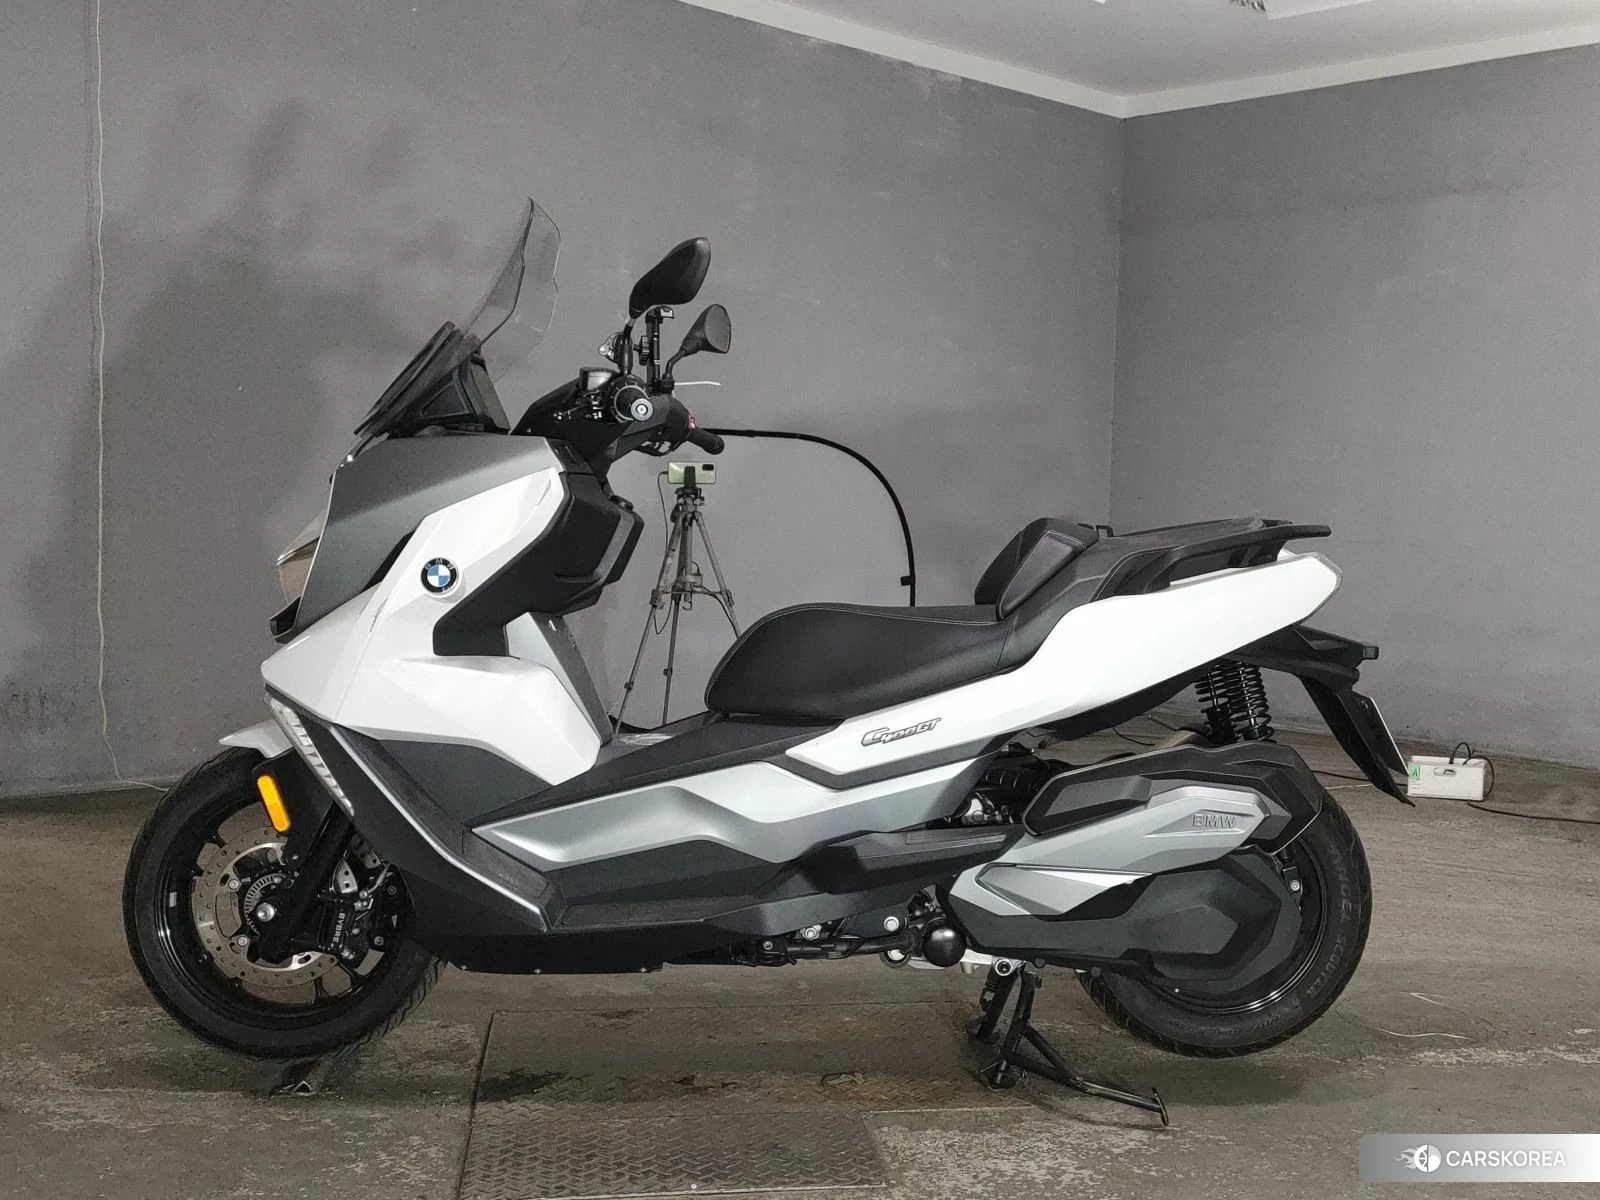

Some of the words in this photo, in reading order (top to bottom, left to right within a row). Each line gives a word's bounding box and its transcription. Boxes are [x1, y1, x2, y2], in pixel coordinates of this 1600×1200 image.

[424, 557, 456, 570] BMW
[1192, 813, 1236, 829] BMW
[333, 912, 346, 943] BYBRE
